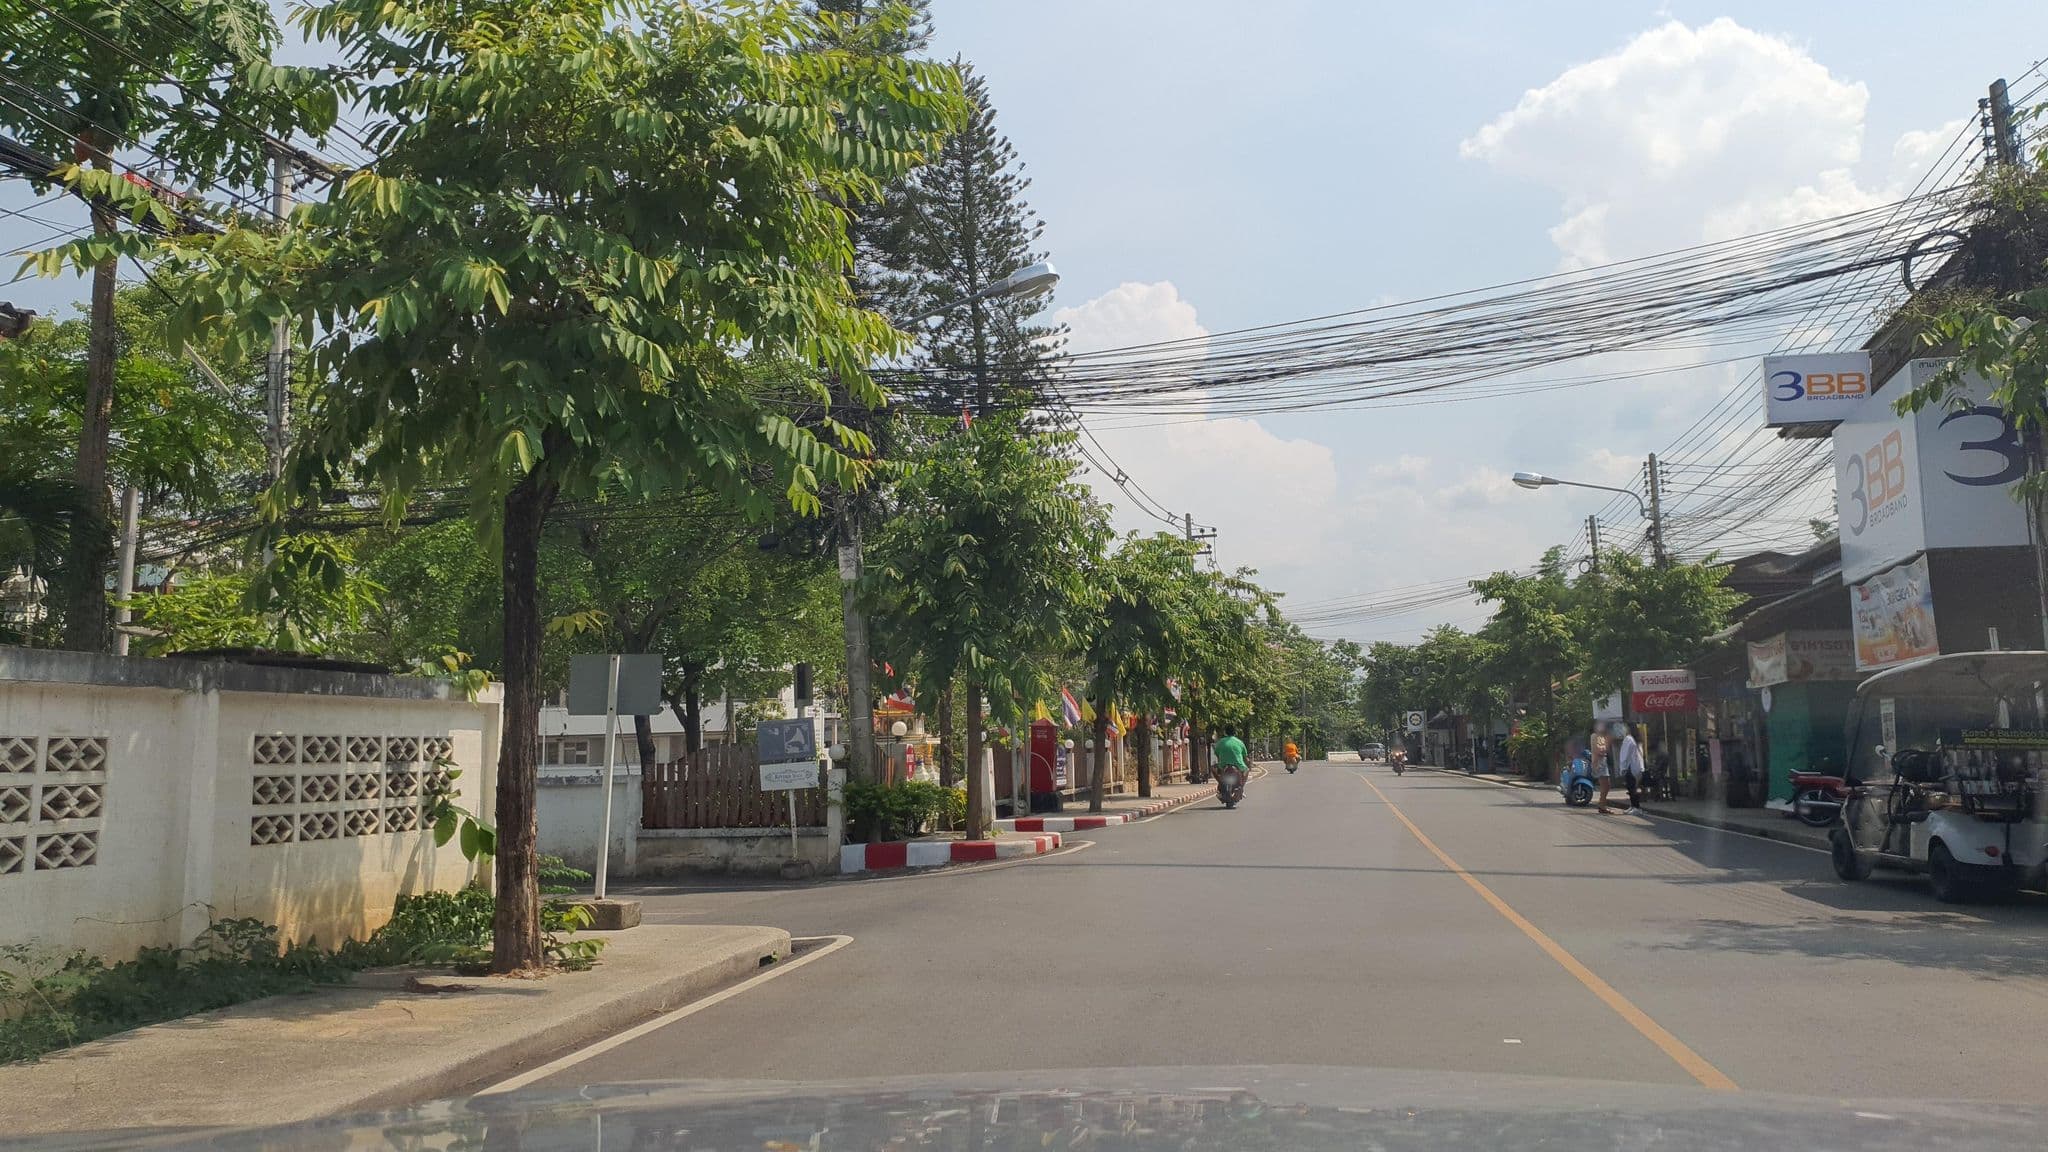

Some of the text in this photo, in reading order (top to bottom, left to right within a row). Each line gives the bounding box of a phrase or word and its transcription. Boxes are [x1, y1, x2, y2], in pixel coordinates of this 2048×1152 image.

[1770, 371, 1866, 401] 3BB
[1846, 429, 1905, 536] 3BB
[1869, 495, 1908, 527] BROADBAND
